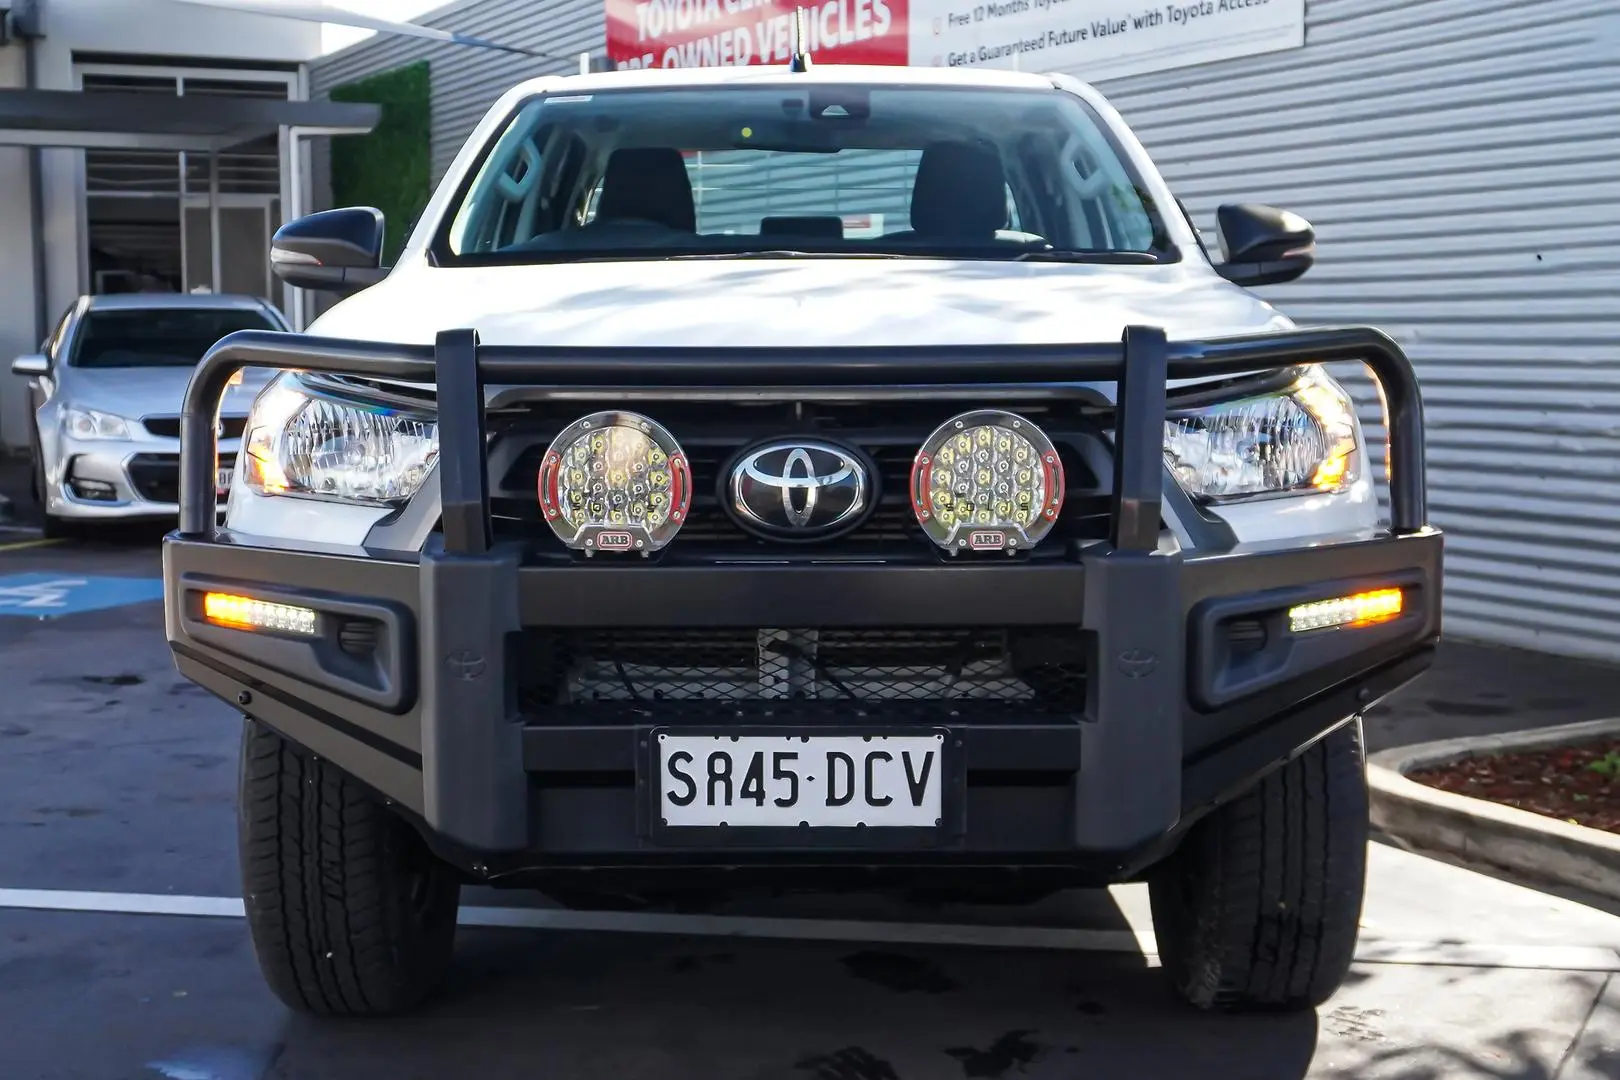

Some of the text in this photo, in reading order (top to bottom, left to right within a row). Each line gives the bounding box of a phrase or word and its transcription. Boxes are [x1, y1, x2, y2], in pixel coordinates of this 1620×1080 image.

[948, 52, 968, 67] Get
[970, 52, 976, 63] a
[978, 31, 1046, 61] Guaranteed
[1048, 28, 1088, 47] Future
[1133, 9, 1163, 29] with
[1166, 1, 1214, 25] Toyota
[1219, 0, 1267, 13] Acce
[602, 535, 628, 545] ARB
[974, 535, 1001, 544] ARB
